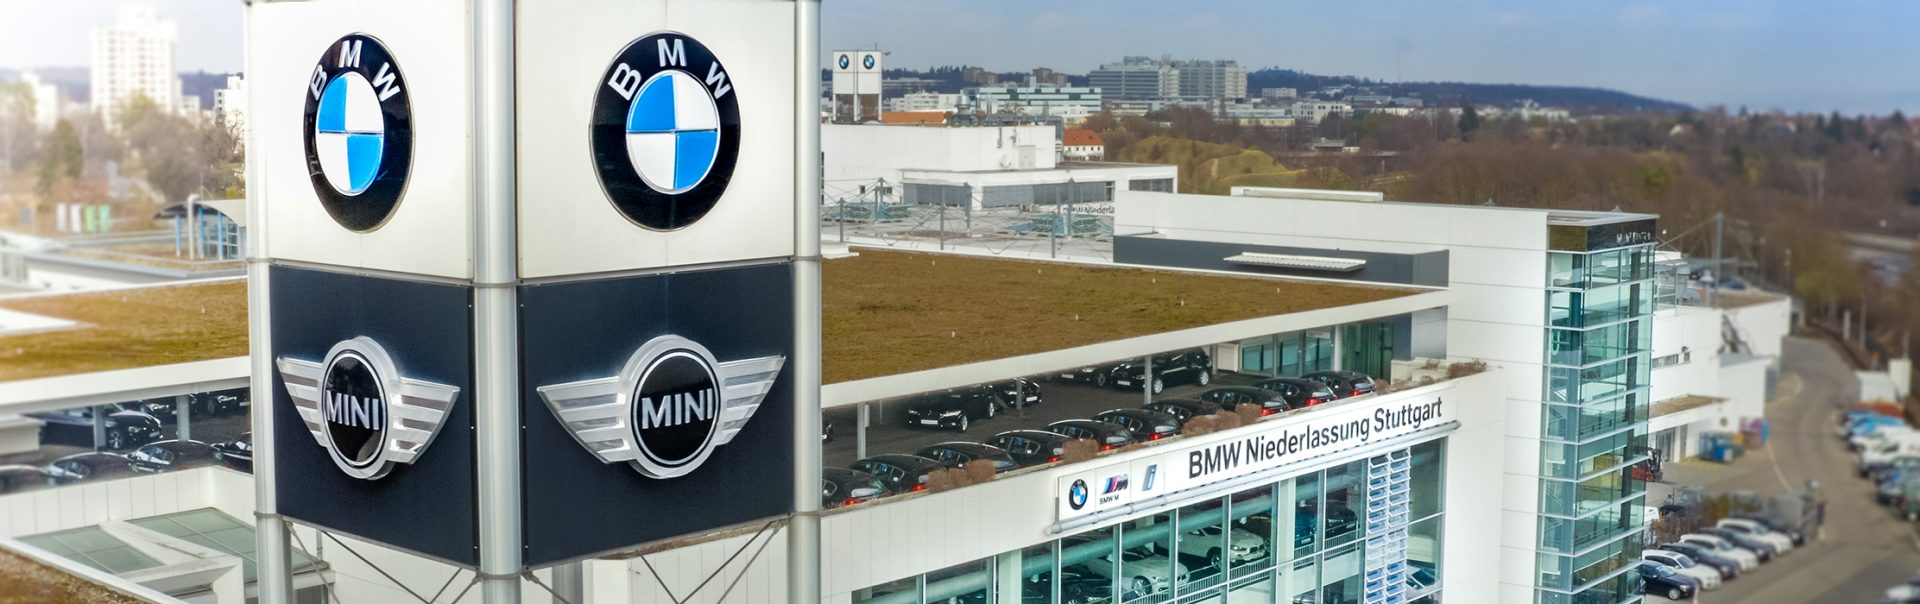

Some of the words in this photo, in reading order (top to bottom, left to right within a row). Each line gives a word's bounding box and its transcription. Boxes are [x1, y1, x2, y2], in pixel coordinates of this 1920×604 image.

[310, 39, 401, 102] BMW
[607, 38, 732, 101] BMW
[325, 390, 379, 431] MINI
[641, 388, 713, 429] MINI
[1188, 440, 1243, 479] BMW
[1245, 416, 1370, 465] Niederlassung
[1373, 396, 1443, 433] Stuttgart
[1099, 495, 1114, 505] BMW
